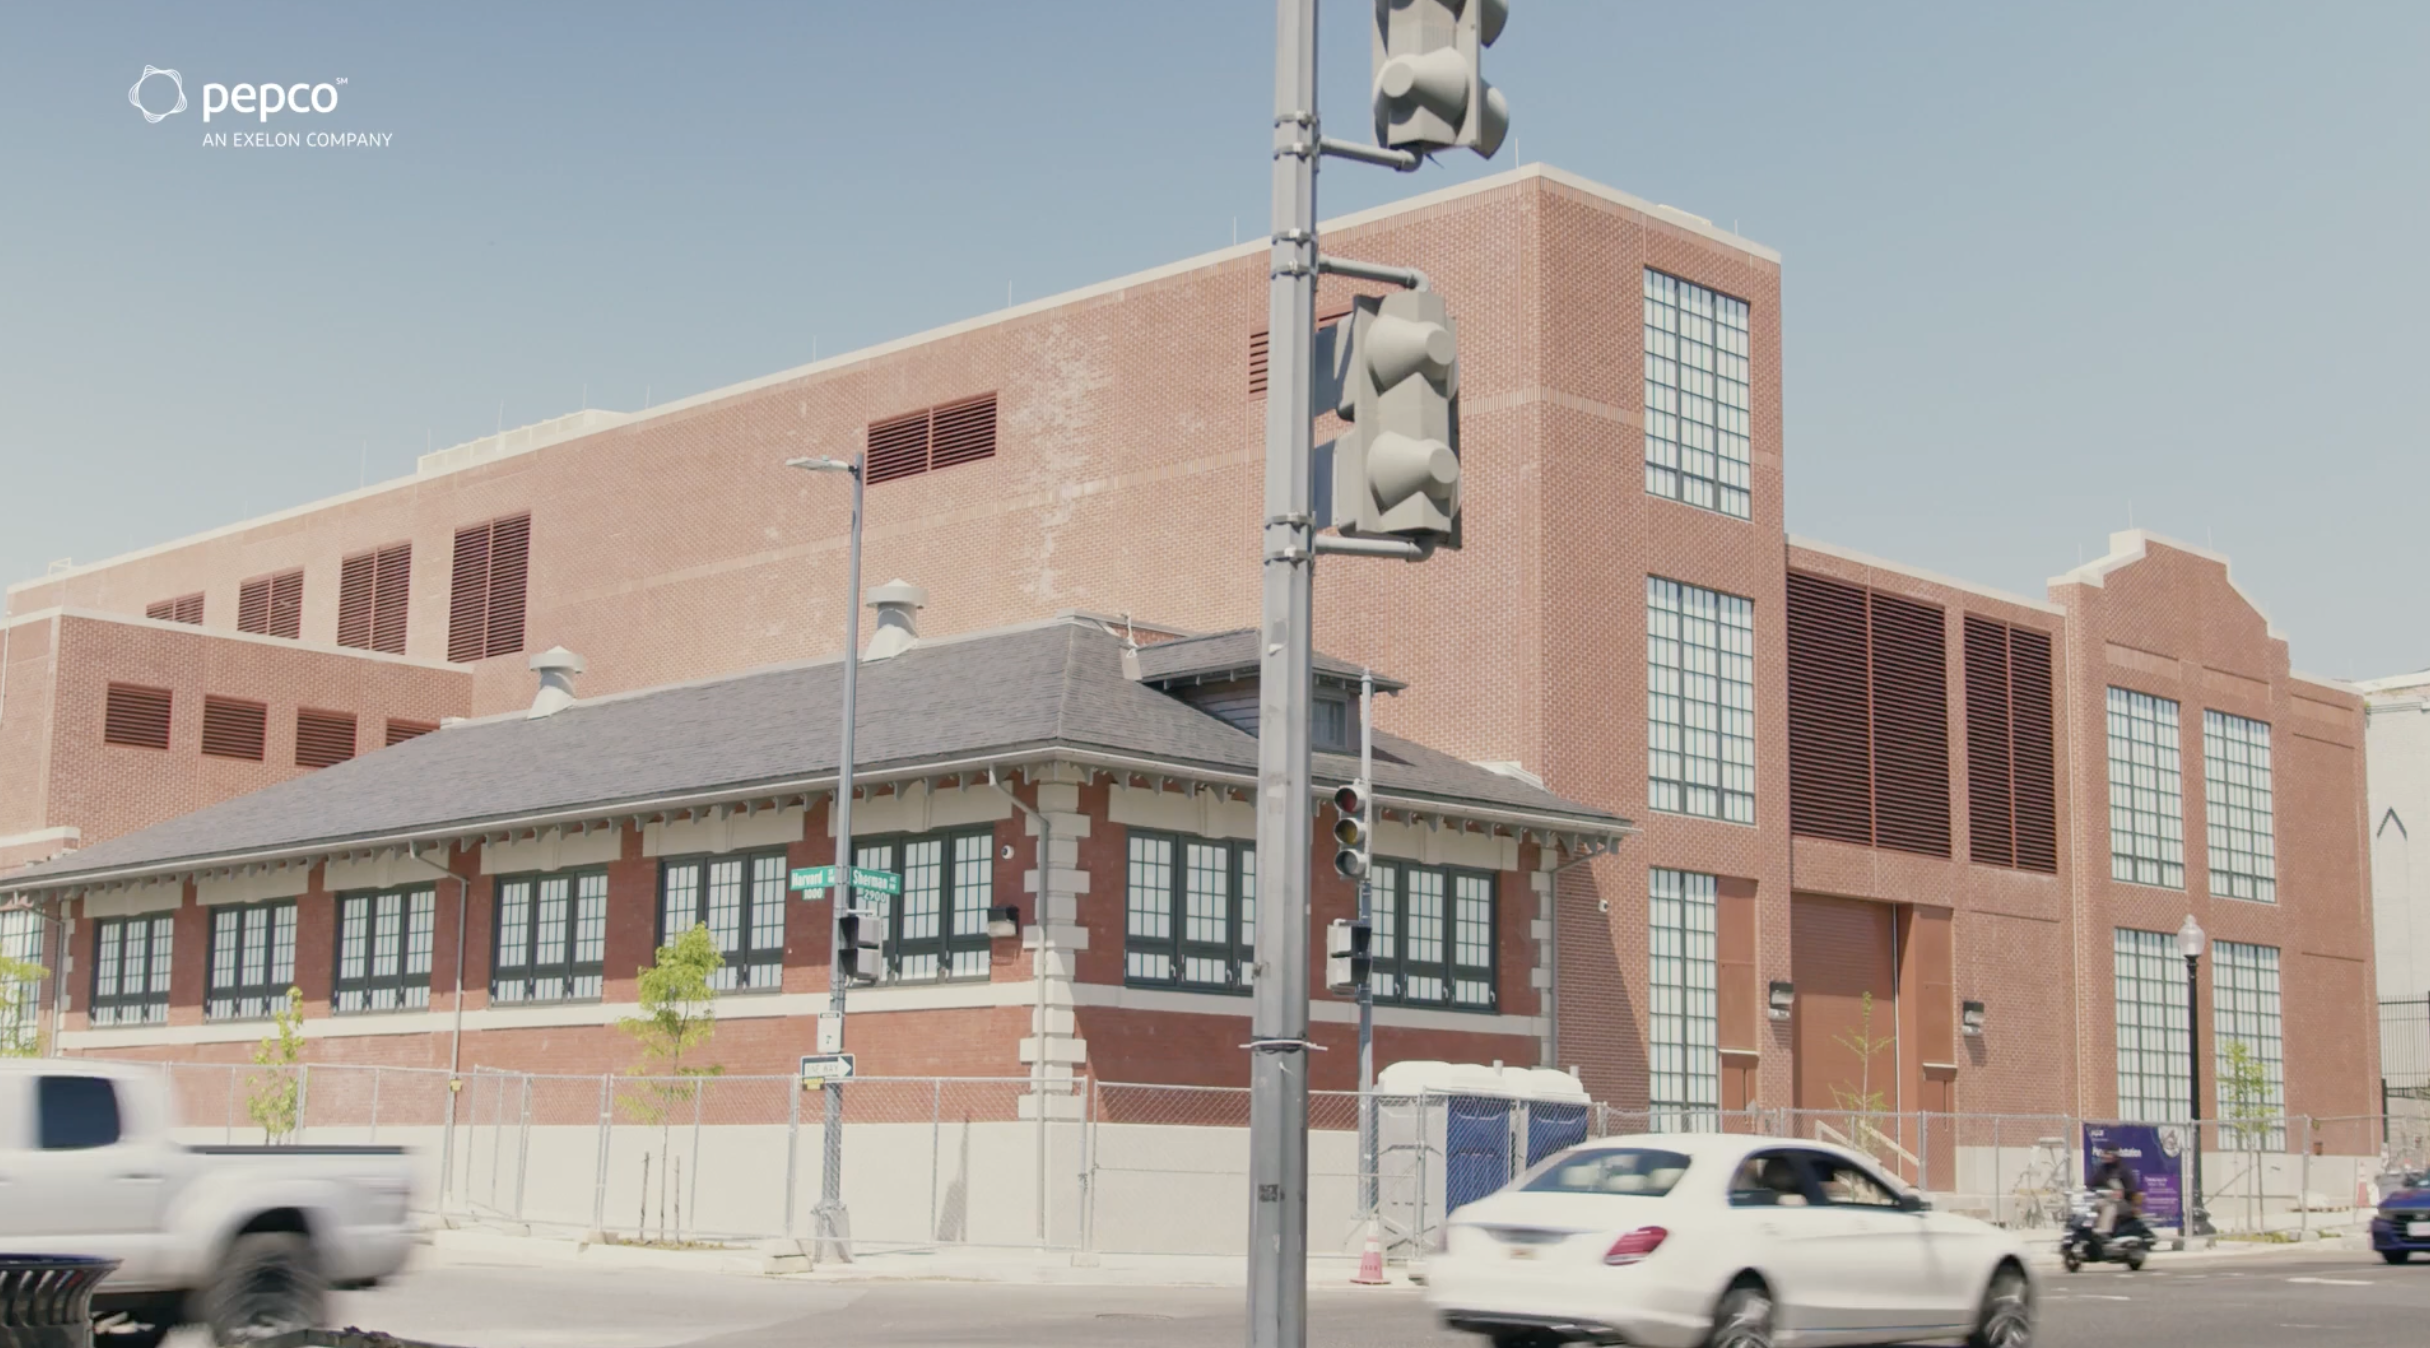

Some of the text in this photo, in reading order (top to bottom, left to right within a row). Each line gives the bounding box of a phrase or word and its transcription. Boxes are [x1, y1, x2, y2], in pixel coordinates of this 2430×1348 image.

[791, 870, 823, 887] Harvard
[852, 869, 888, 890] Sherman
[804, 888, 823, 899] 1000
[863, 889, 886, 902] 2900
